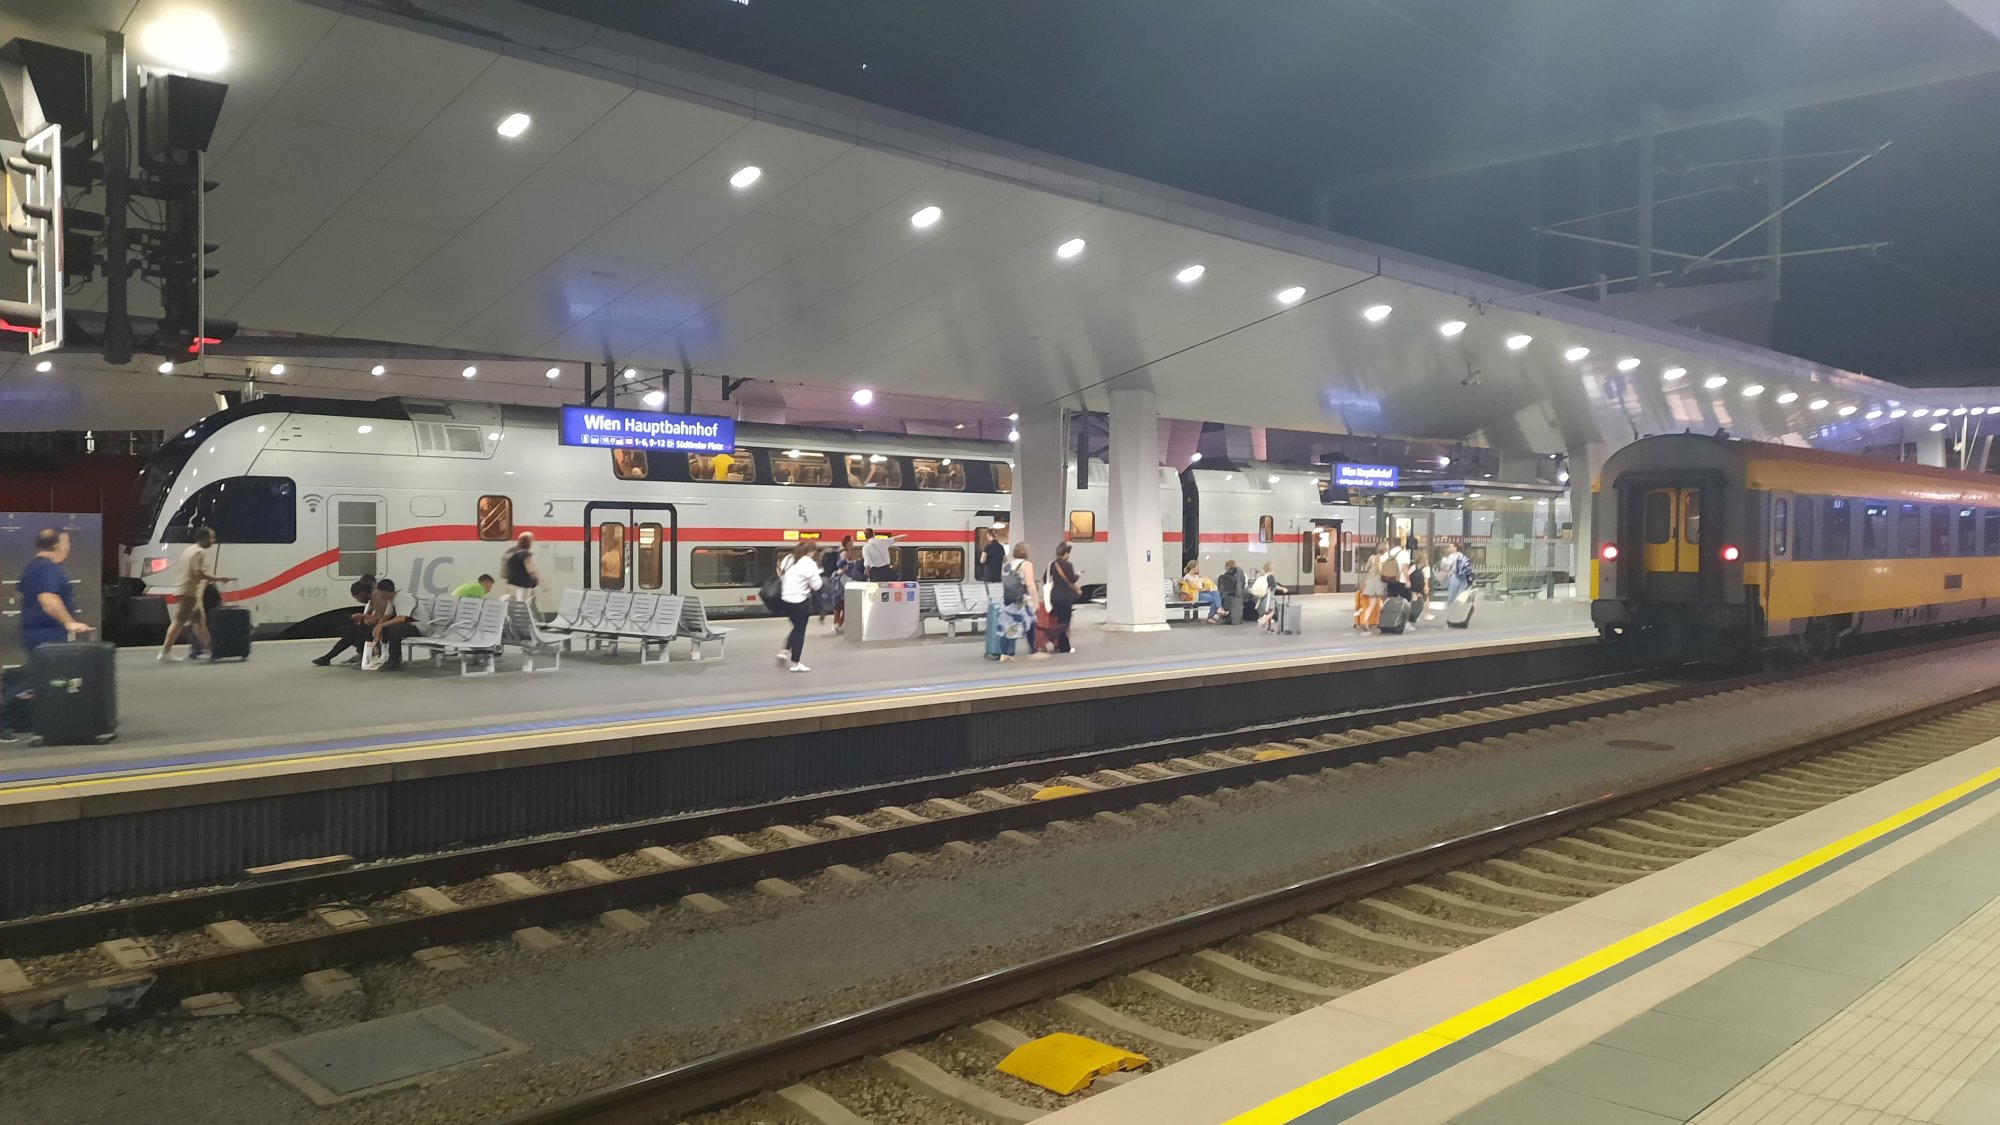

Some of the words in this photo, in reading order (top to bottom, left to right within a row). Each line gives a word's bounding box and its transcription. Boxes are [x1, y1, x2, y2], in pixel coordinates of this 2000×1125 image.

[584, 415, 621, 431] Wien
[624, 418, 719, 437] Hauptbahnhof
[543, 501, 554, 518] 2
[407, 556, 454, 595] IC
[298, 587, 328, 599] 4101
